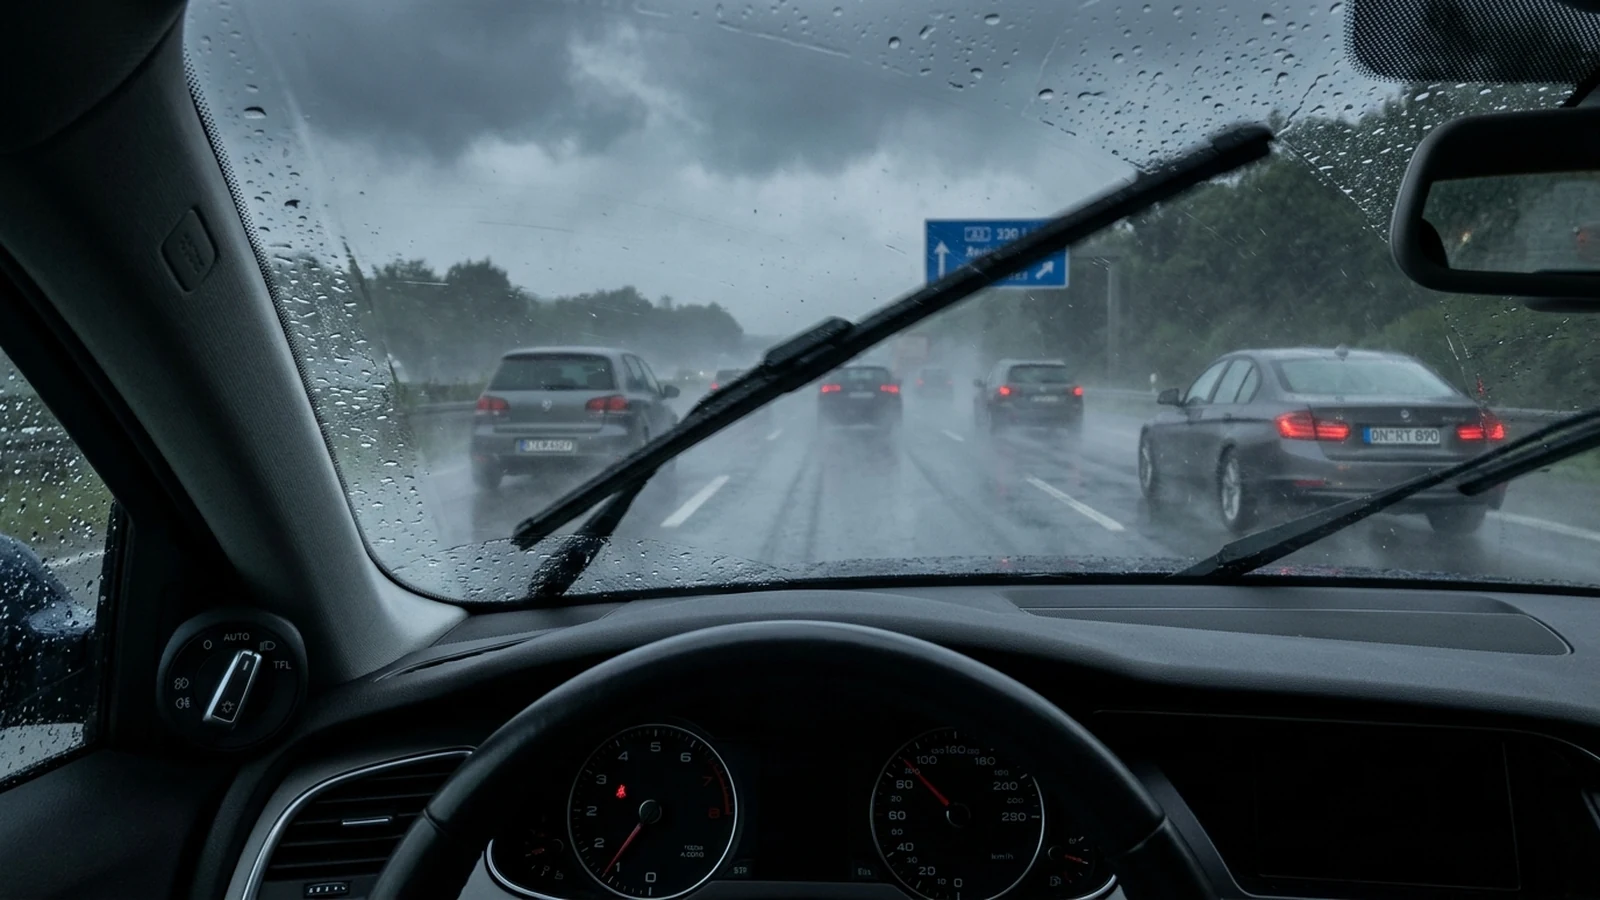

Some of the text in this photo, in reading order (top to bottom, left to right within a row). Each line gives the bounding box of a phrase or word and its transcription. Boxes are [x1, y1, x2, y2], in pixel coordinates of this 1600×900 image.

[224, 633, 249, 641] AUTO
[273, 660, 292, 670] TFL
[651, 742, 661, 752] 5
[618, 751, 628, 761] 4
[680, 752, 692, 763] 6
[917, 755, 937, 765] 100
[596, 775, 606, 784] 3
[703, 776, 713, 786] 7
[586, 806, 597, 816] 2
[889, 811, 906, 820] 60
[594, 838, 604, 848] 2
[897, 843, 913, 851] 40
[616, 861, 621, 872] 1
[919, 867, 935, 875] 20
[645, 872, 656, 882] 0
[954, 878, 962, 887] 0
